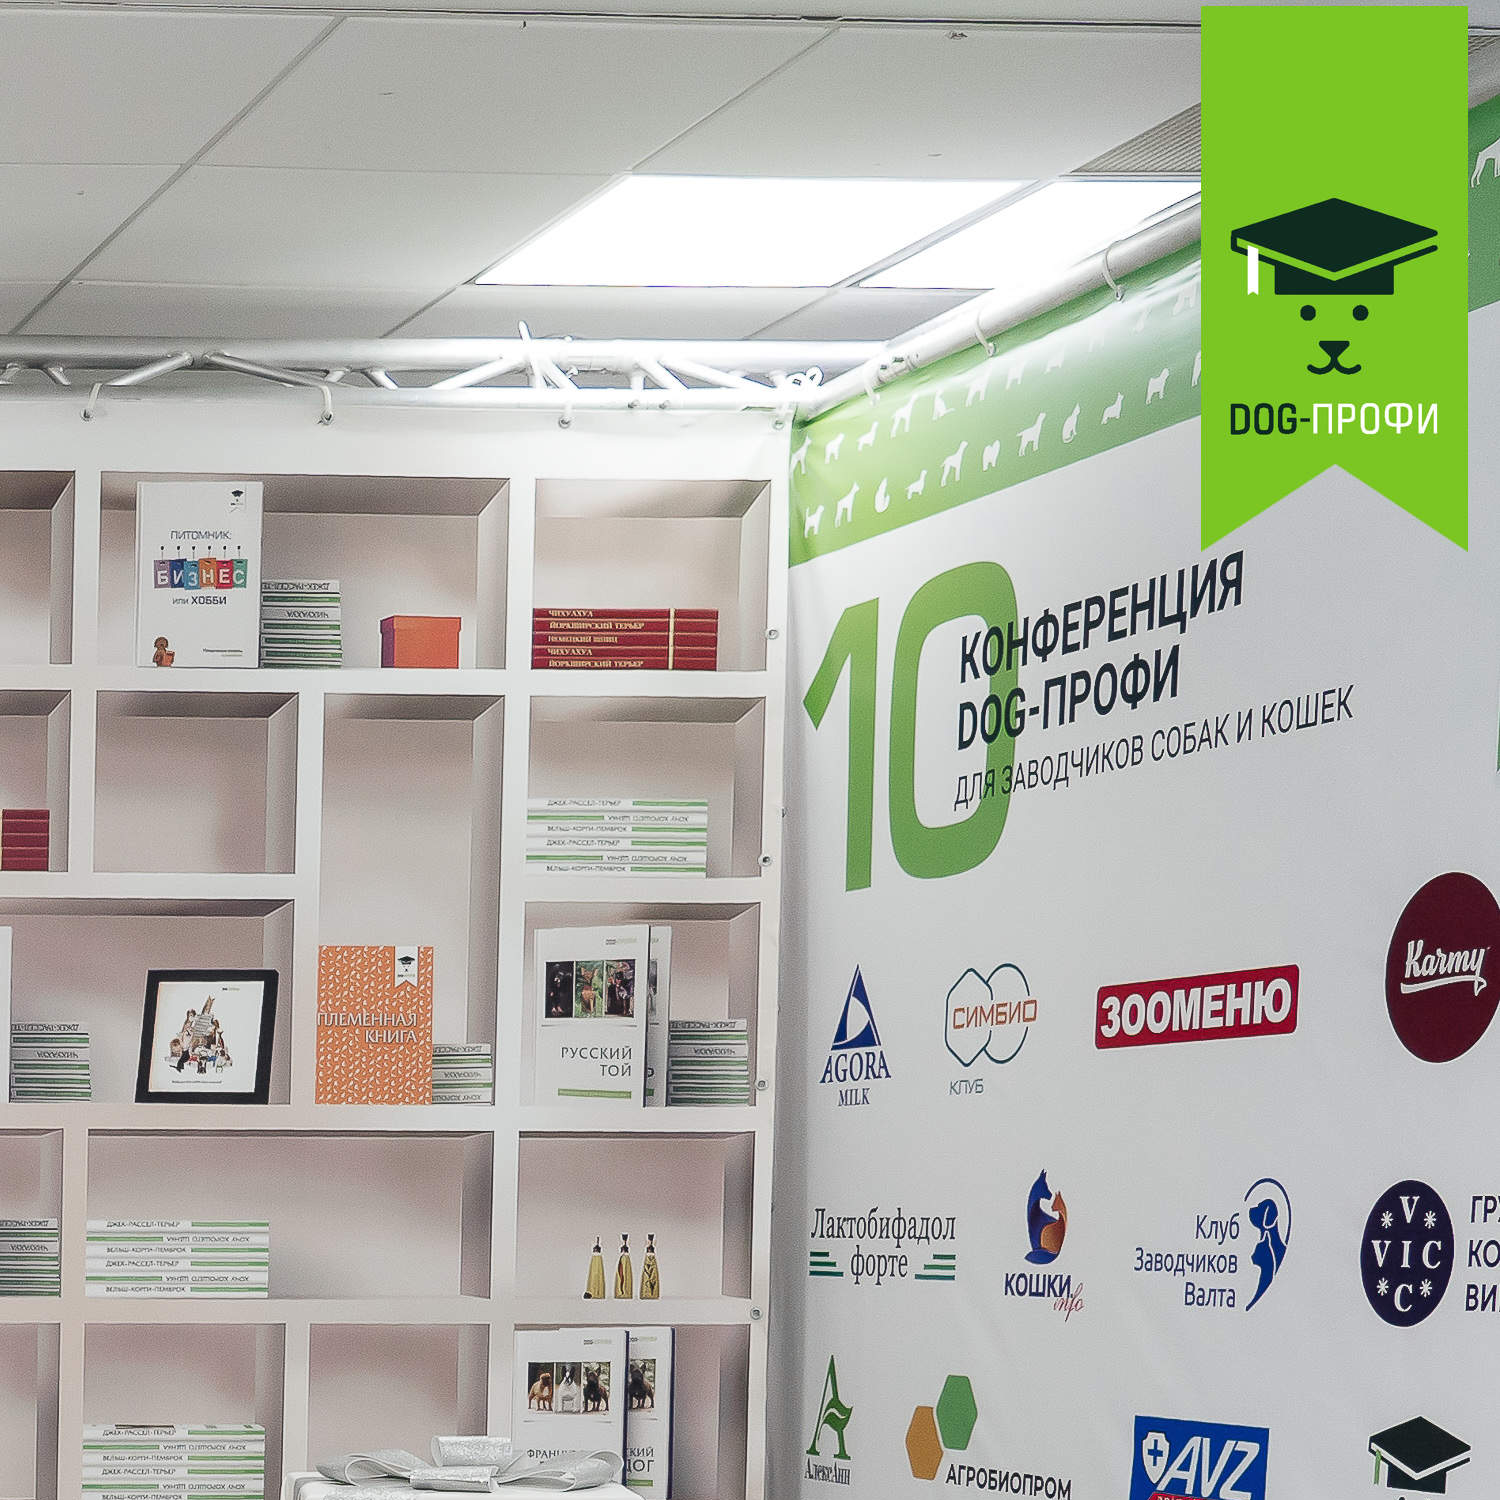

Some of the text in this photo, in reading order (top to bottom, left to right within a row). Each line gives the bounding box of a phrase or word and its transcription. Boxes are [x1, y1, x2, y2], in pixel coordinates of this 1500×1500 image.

[169, 528, 232, 543] ПИТОМНИК:
[155, 565, 247, 590] БИЗНЕС
[190, 595, 228, 607] ХОББИ
[959, 548, 1246, 685] КОНФЕРЕНЦИЯ
[956, 643, 1182, 753] DOG-ПРОФИ
[802, 560, 1020, 894] 10
[953, 683, 1355, 812] ДЛЯ ЗАВОДЧИКОВ СОБАК И КОШЕК
[1402, 939, 1488, 996] Karmy
[316, 1010, 418, 1028] ПЛЕМЕННАЯ
[952, 997, 1039, 1031] СИМБИО
[1099, 977, 1293, 1040] ЗООМЕНЮ
[364, 1028, 418, 1045] КНИГА
[559, 1044, 634, 1062] РУССКИЙ
[598, 1061, 633, 1078] ТОЙ
[818, 1048, 893, 1085] AGORA
[837, 1086, 872, 1108] MILK
[948, 1077, 985, 1097] КЛУБ
[810, 1206, 957, 1249] Лактобифадол
[1195, 1214, 1241, 1247] Клуб
[850, 1244, 909, 1286] форте
[1133, 1245, 1239, 1280] Заводчиков
[1182, 1280, 1237, 1312] Валта
